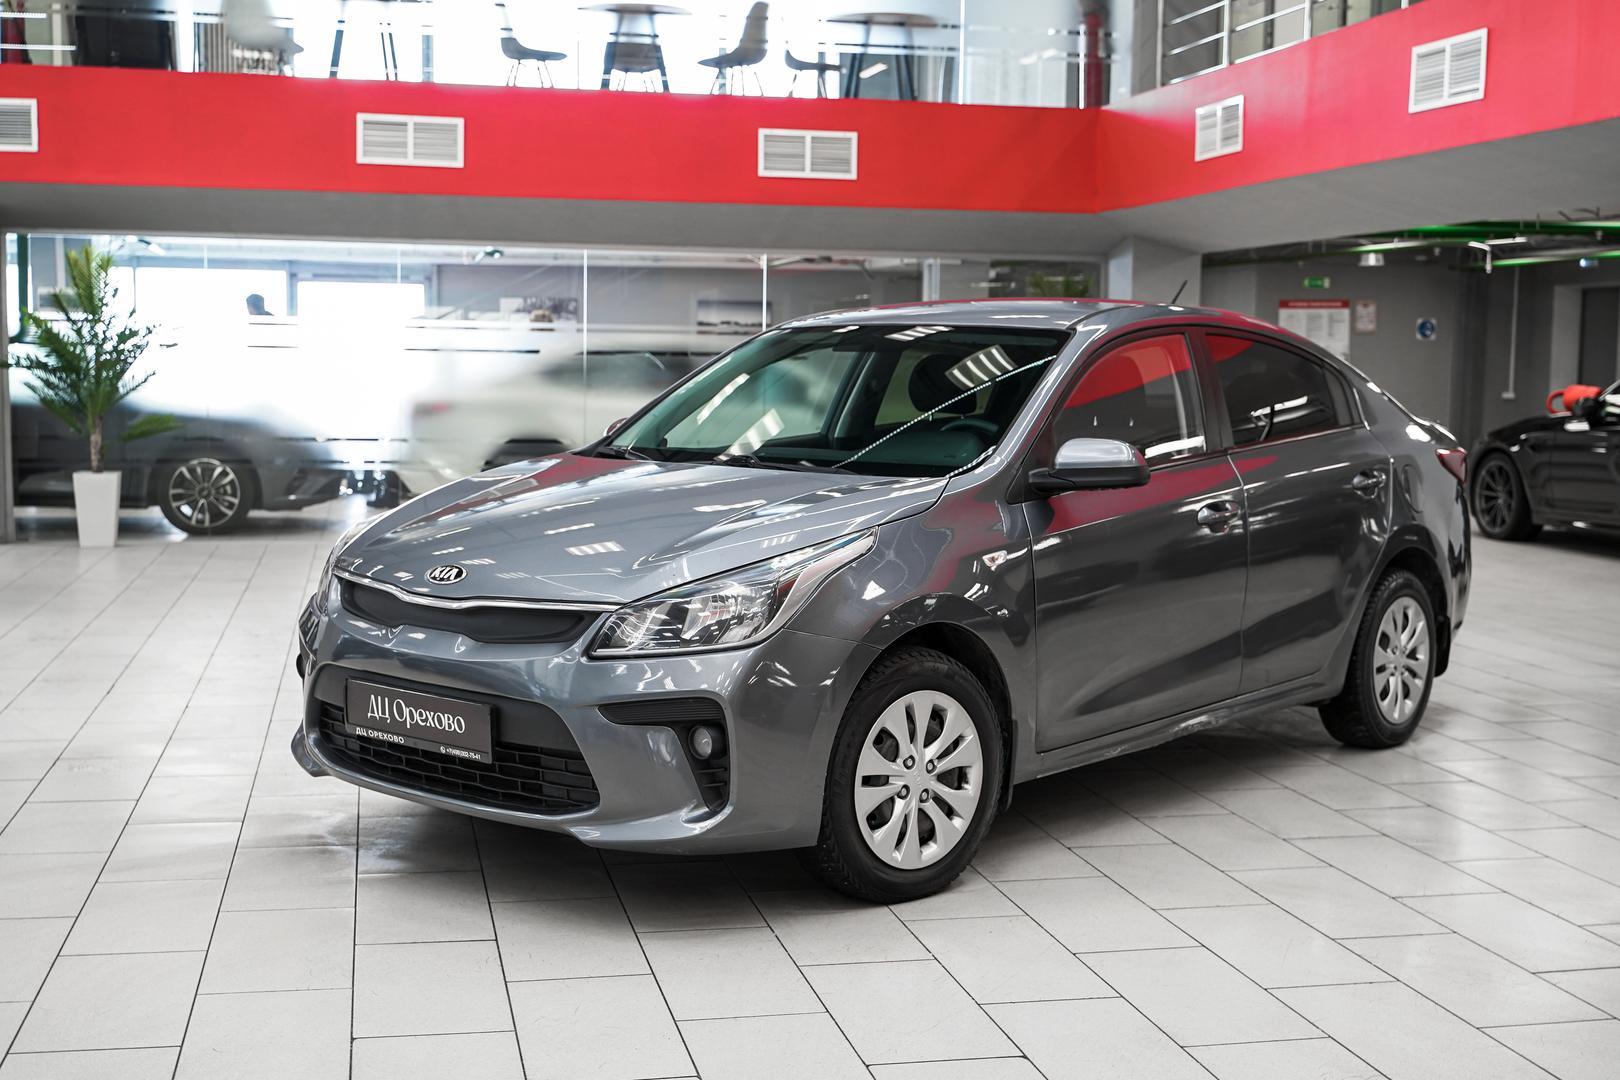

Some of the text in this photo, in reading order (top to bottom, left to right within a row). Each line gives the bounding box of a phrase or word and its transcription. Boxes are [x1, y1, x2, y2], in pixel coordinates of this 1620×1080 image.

[430, 566, 459, 580] KIA
[368, 694, 466, 734] ДЦ Орехово
[356, 727, 405, 744] ДЦ ОРЕХОВО
